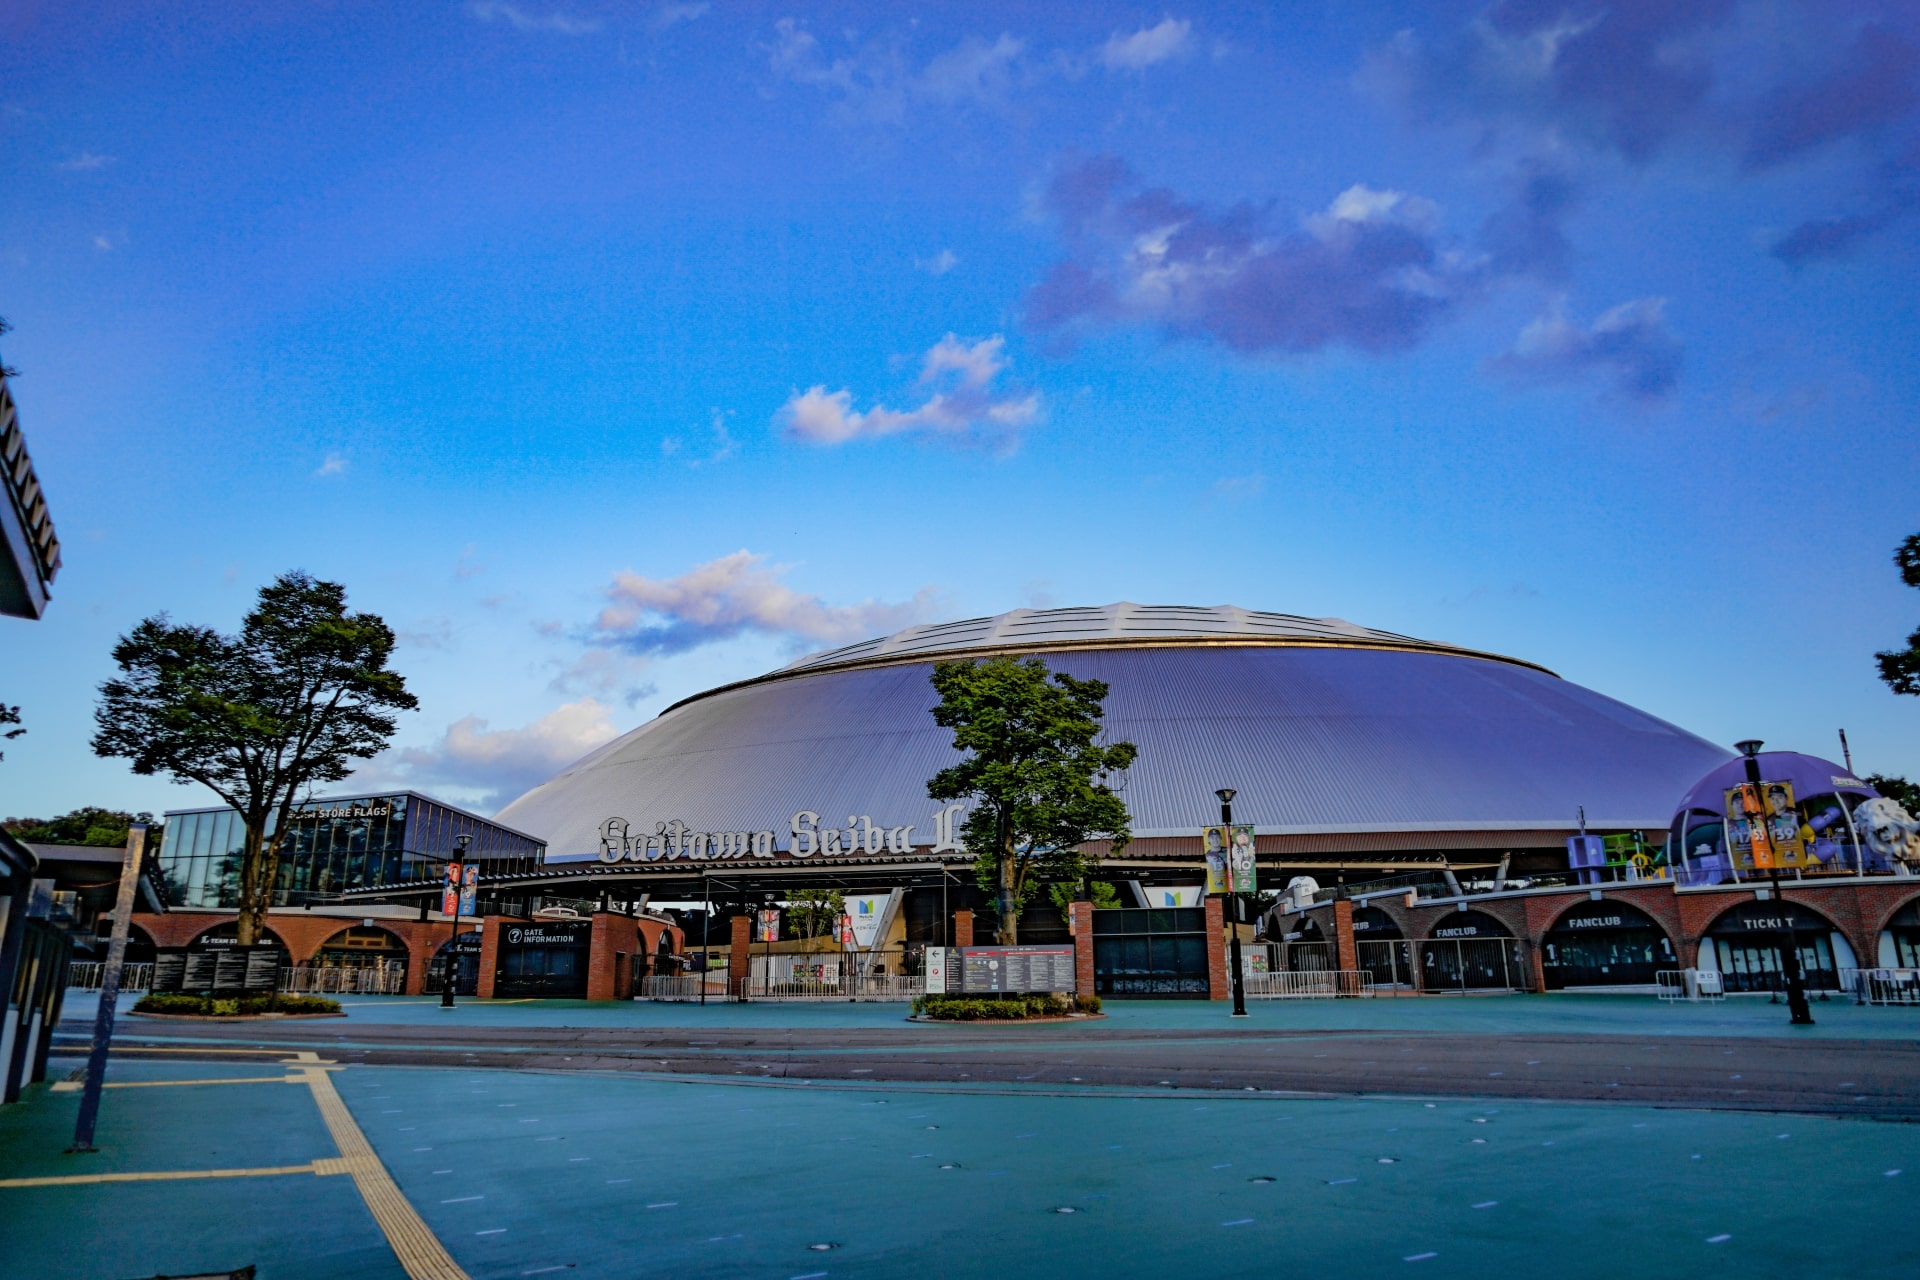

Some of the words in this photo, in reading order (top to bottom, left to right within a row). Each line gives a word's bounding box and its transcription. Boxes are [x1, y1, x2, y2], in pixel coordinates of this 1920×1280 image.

[319, 808, 351, 819] STORE
[354, 807, 387, 817] FLAGS
[599, 816, 776, 864] Saitama
[788, 809, 917, 858] Seibu
[1775, 827, 1795, 841] 39
[1569, 916, 1621, 928] FANCLUB
[1436, 926, 1477, 938] FANCLUB
[523, 935, 574, 943] INFORMATION
[1426, 951, 1435, 967] 2
